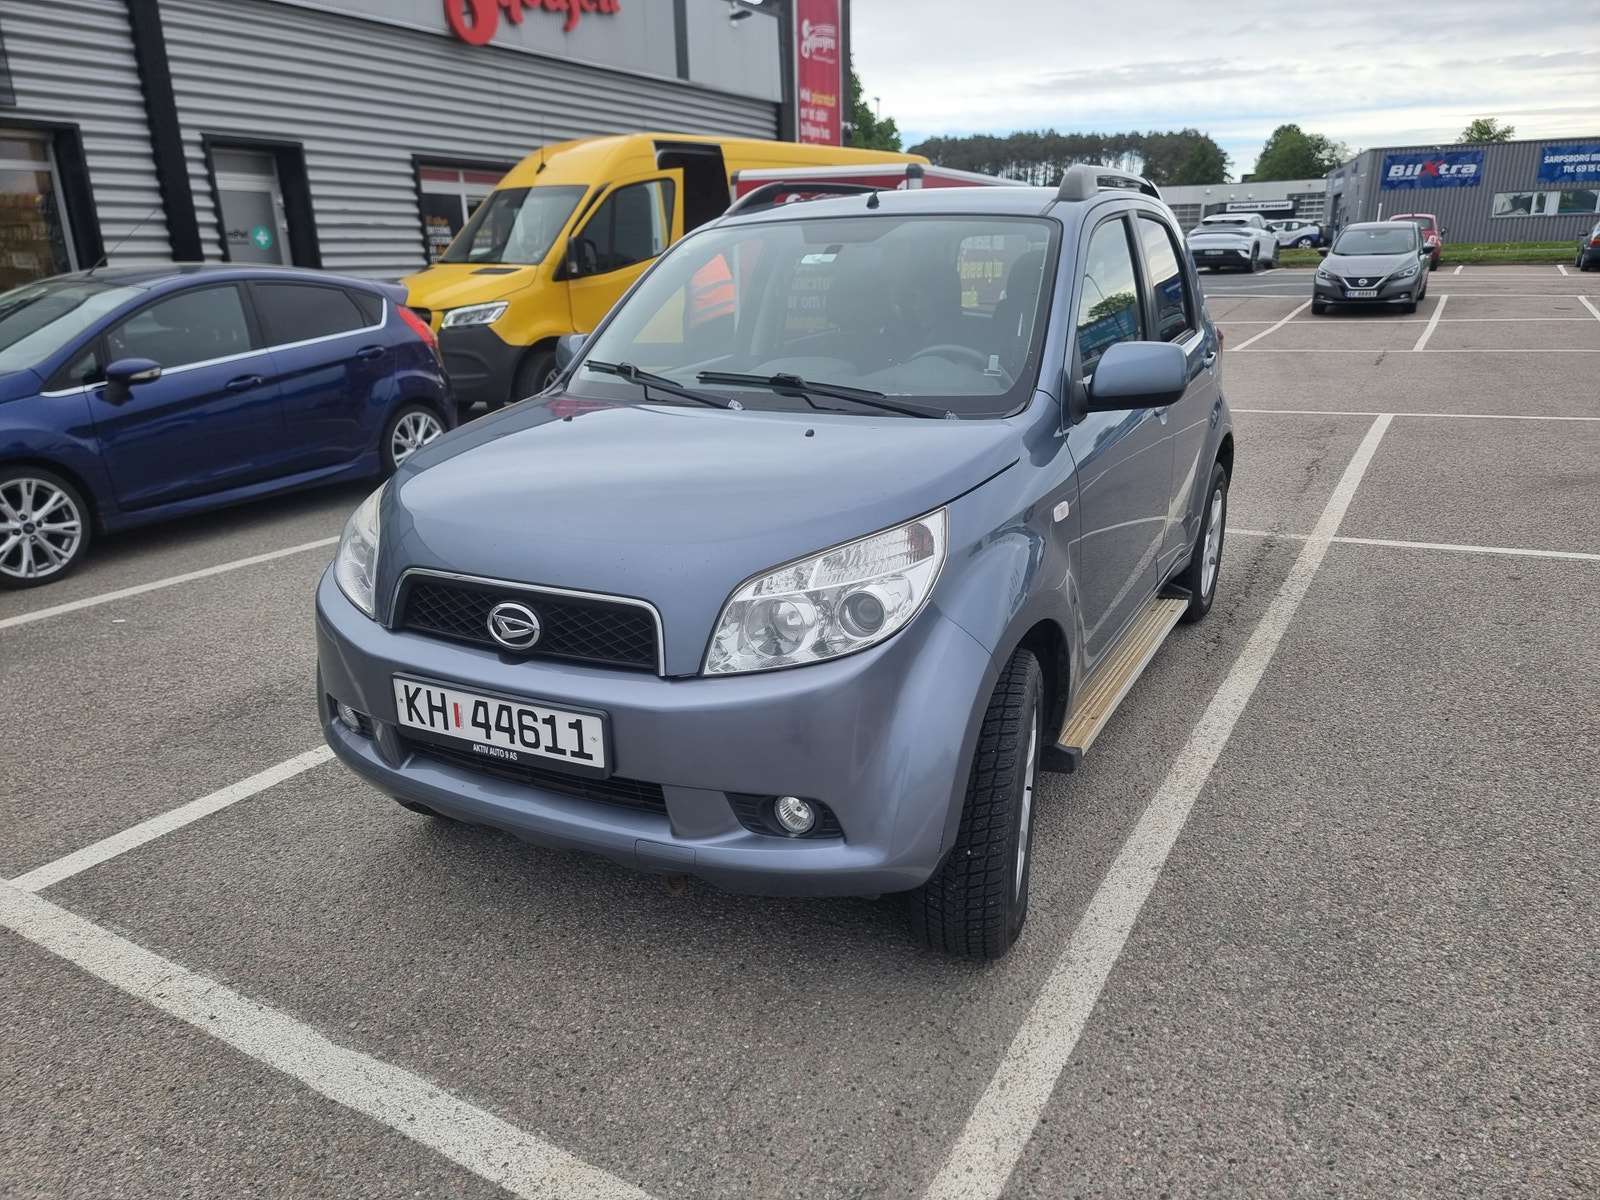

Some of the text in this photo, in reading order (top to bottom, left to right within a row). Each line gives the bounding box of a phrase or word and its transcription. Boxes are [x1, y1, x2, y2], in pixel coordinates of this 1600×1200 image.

[1544, 154, 1590, 163] SARPSBORG
[1388, 160, 1477, 177] BilXtra
[1576, 165, 1587, 173] 69
[404, 684, 450, 731] KH
[471, 699, 594, 761] 44611
[473, 743, 489, 754] AKTIV
[489, 746, 505, 758] AUTO
[510, 751, 518, 761] AS
